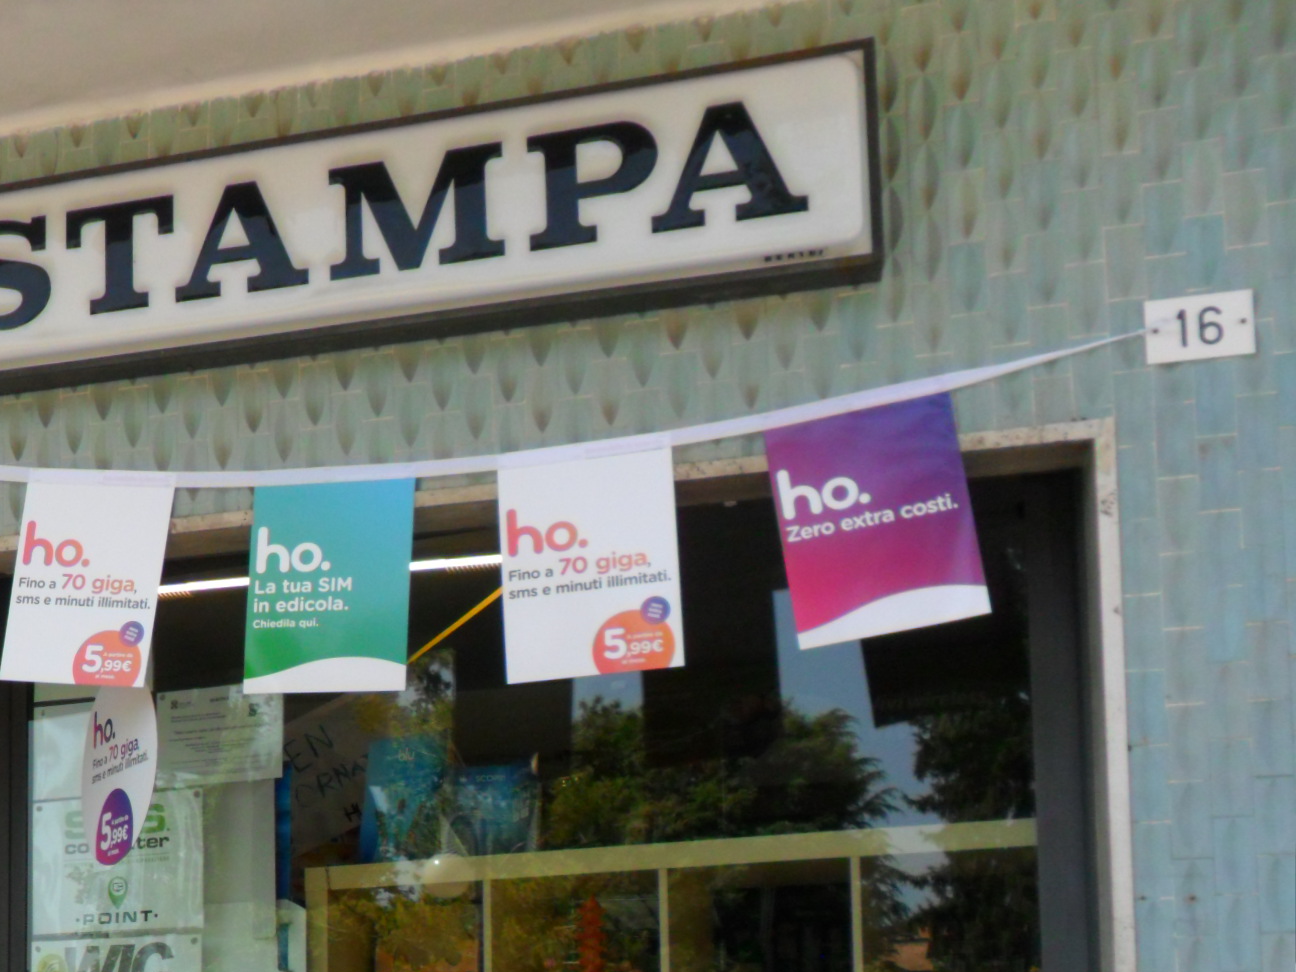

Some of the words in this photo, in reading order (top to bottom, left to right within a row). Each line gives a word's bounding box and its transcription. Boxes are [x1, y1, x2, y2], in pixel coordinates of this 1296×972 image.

[1176, 306, 1224, 347] 16
[776, 469, 871, 520] ho.
[506, 509, 588, 557] ho.
[787, 521, 835, 542] Zero
[841, 508, 895, 531] extra
[900, 494, 958, 518] costi.
[22, 520, 90, 567] ho.
[256, 527, 331, 574] ho.
[508, 569, 540, 582] Fino
[545, 567, 553, 577] a
[559, 557, 587, 575] 70
[596, 552, 651, 574] giga,
[19, 577, 45, 588] Fino
[49, 579, 56, 589] a
[61, 574, 86, 590] 70
[91, 575, 137, 595] giga,
[255, 580, 276, 594] La
[283, 580, 312, 593] tua
[318, 577, 352, 592] SIM
[509, 587, 537, 600] sms
[542, 586, 551, 595] e
[556, 577, 602, 594] minuti
[607, 570, 672, 587] illimitati.
[16, 595, 40, 604] sms
[44, 597, 51, 605] e
[55, 595, 94, 607] minuti
[98, 597, 151, 609] illimitati.
[253, 598, 269, 613] in
[276, 596, 349, 612] edicola.
[253, 619, 296, 628] Chiedila
[299, 618, 318, 628] qui.
[94, 712, 115, 749] ho.
[93, 758, 102, 769] Fino
[109, 746, 118, 759] 70
[92, 773, 102, 784] sms
[107, 762, 123, 776] minuti
